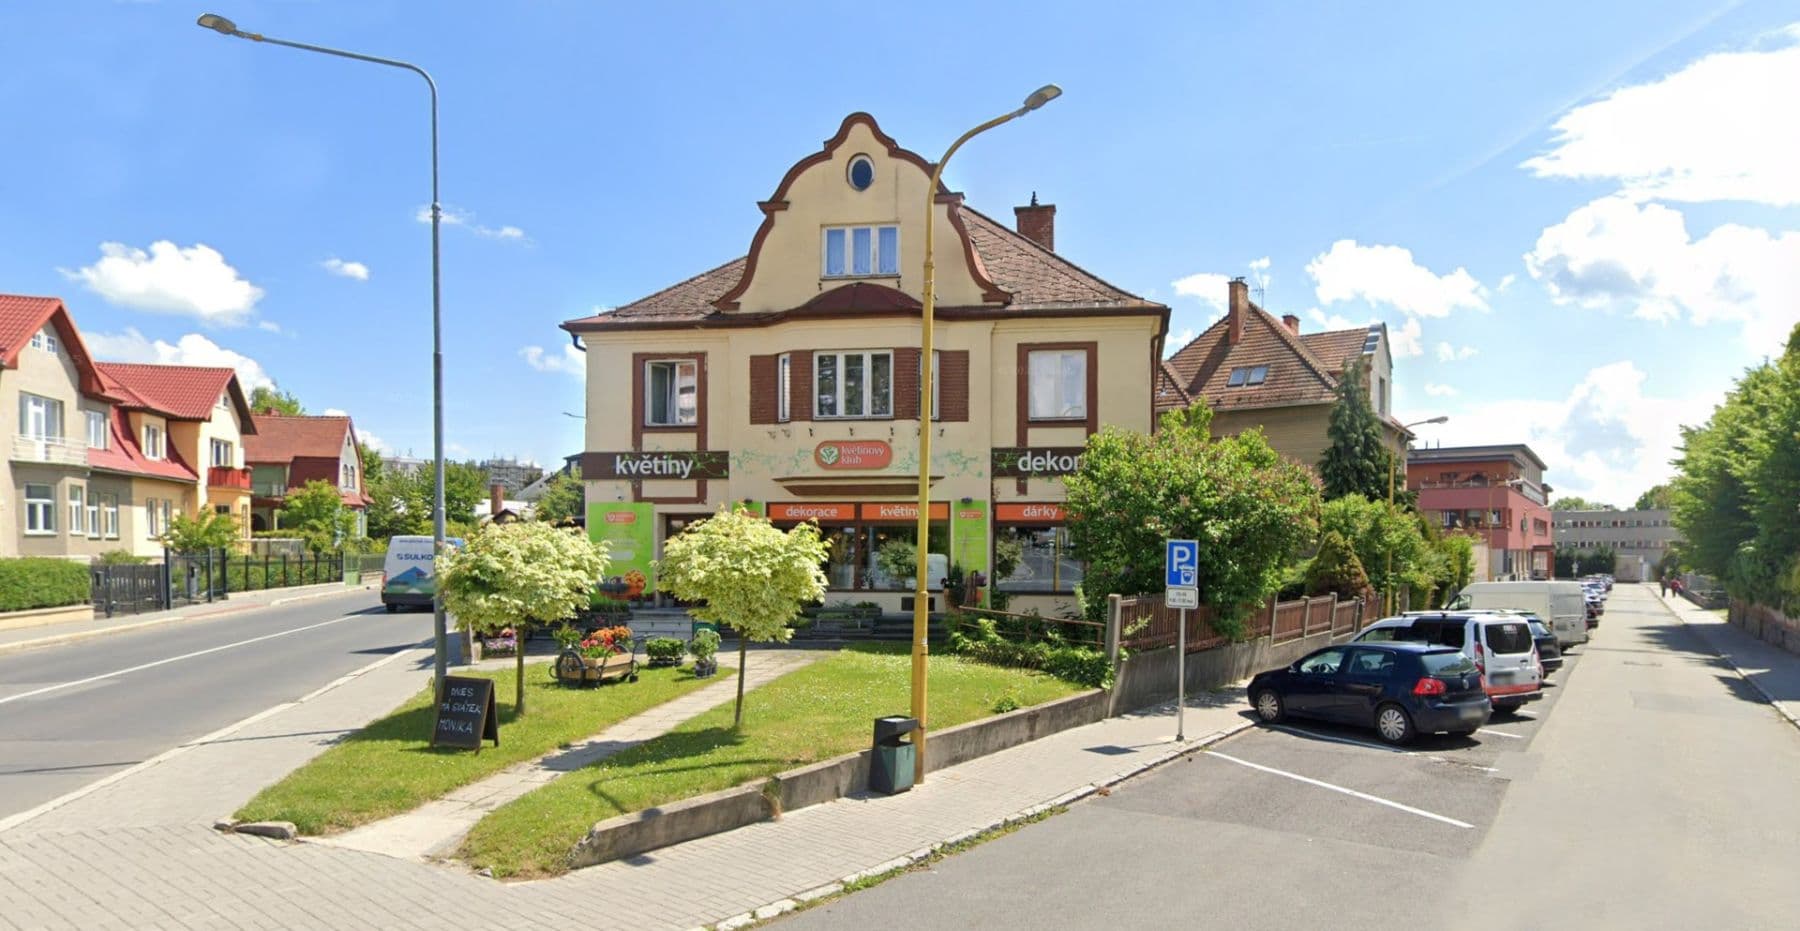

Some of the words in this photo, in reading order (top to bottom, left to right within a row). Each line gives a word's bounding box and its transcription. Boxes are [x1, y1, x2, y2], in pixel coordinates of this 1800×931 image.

[615, 455, 694, 479] květiny
[841, 455, 862, 465] klub
[1018, 451, 1079, 472] dekor
[785, 505, 838, 517] dekorace
[1023, 505, 1058, 519] dárky
[403, 553, 434, 561] SULKO
[1172, 545, 1191, 572] P
[438, 719, 473, 734] MONIKA
